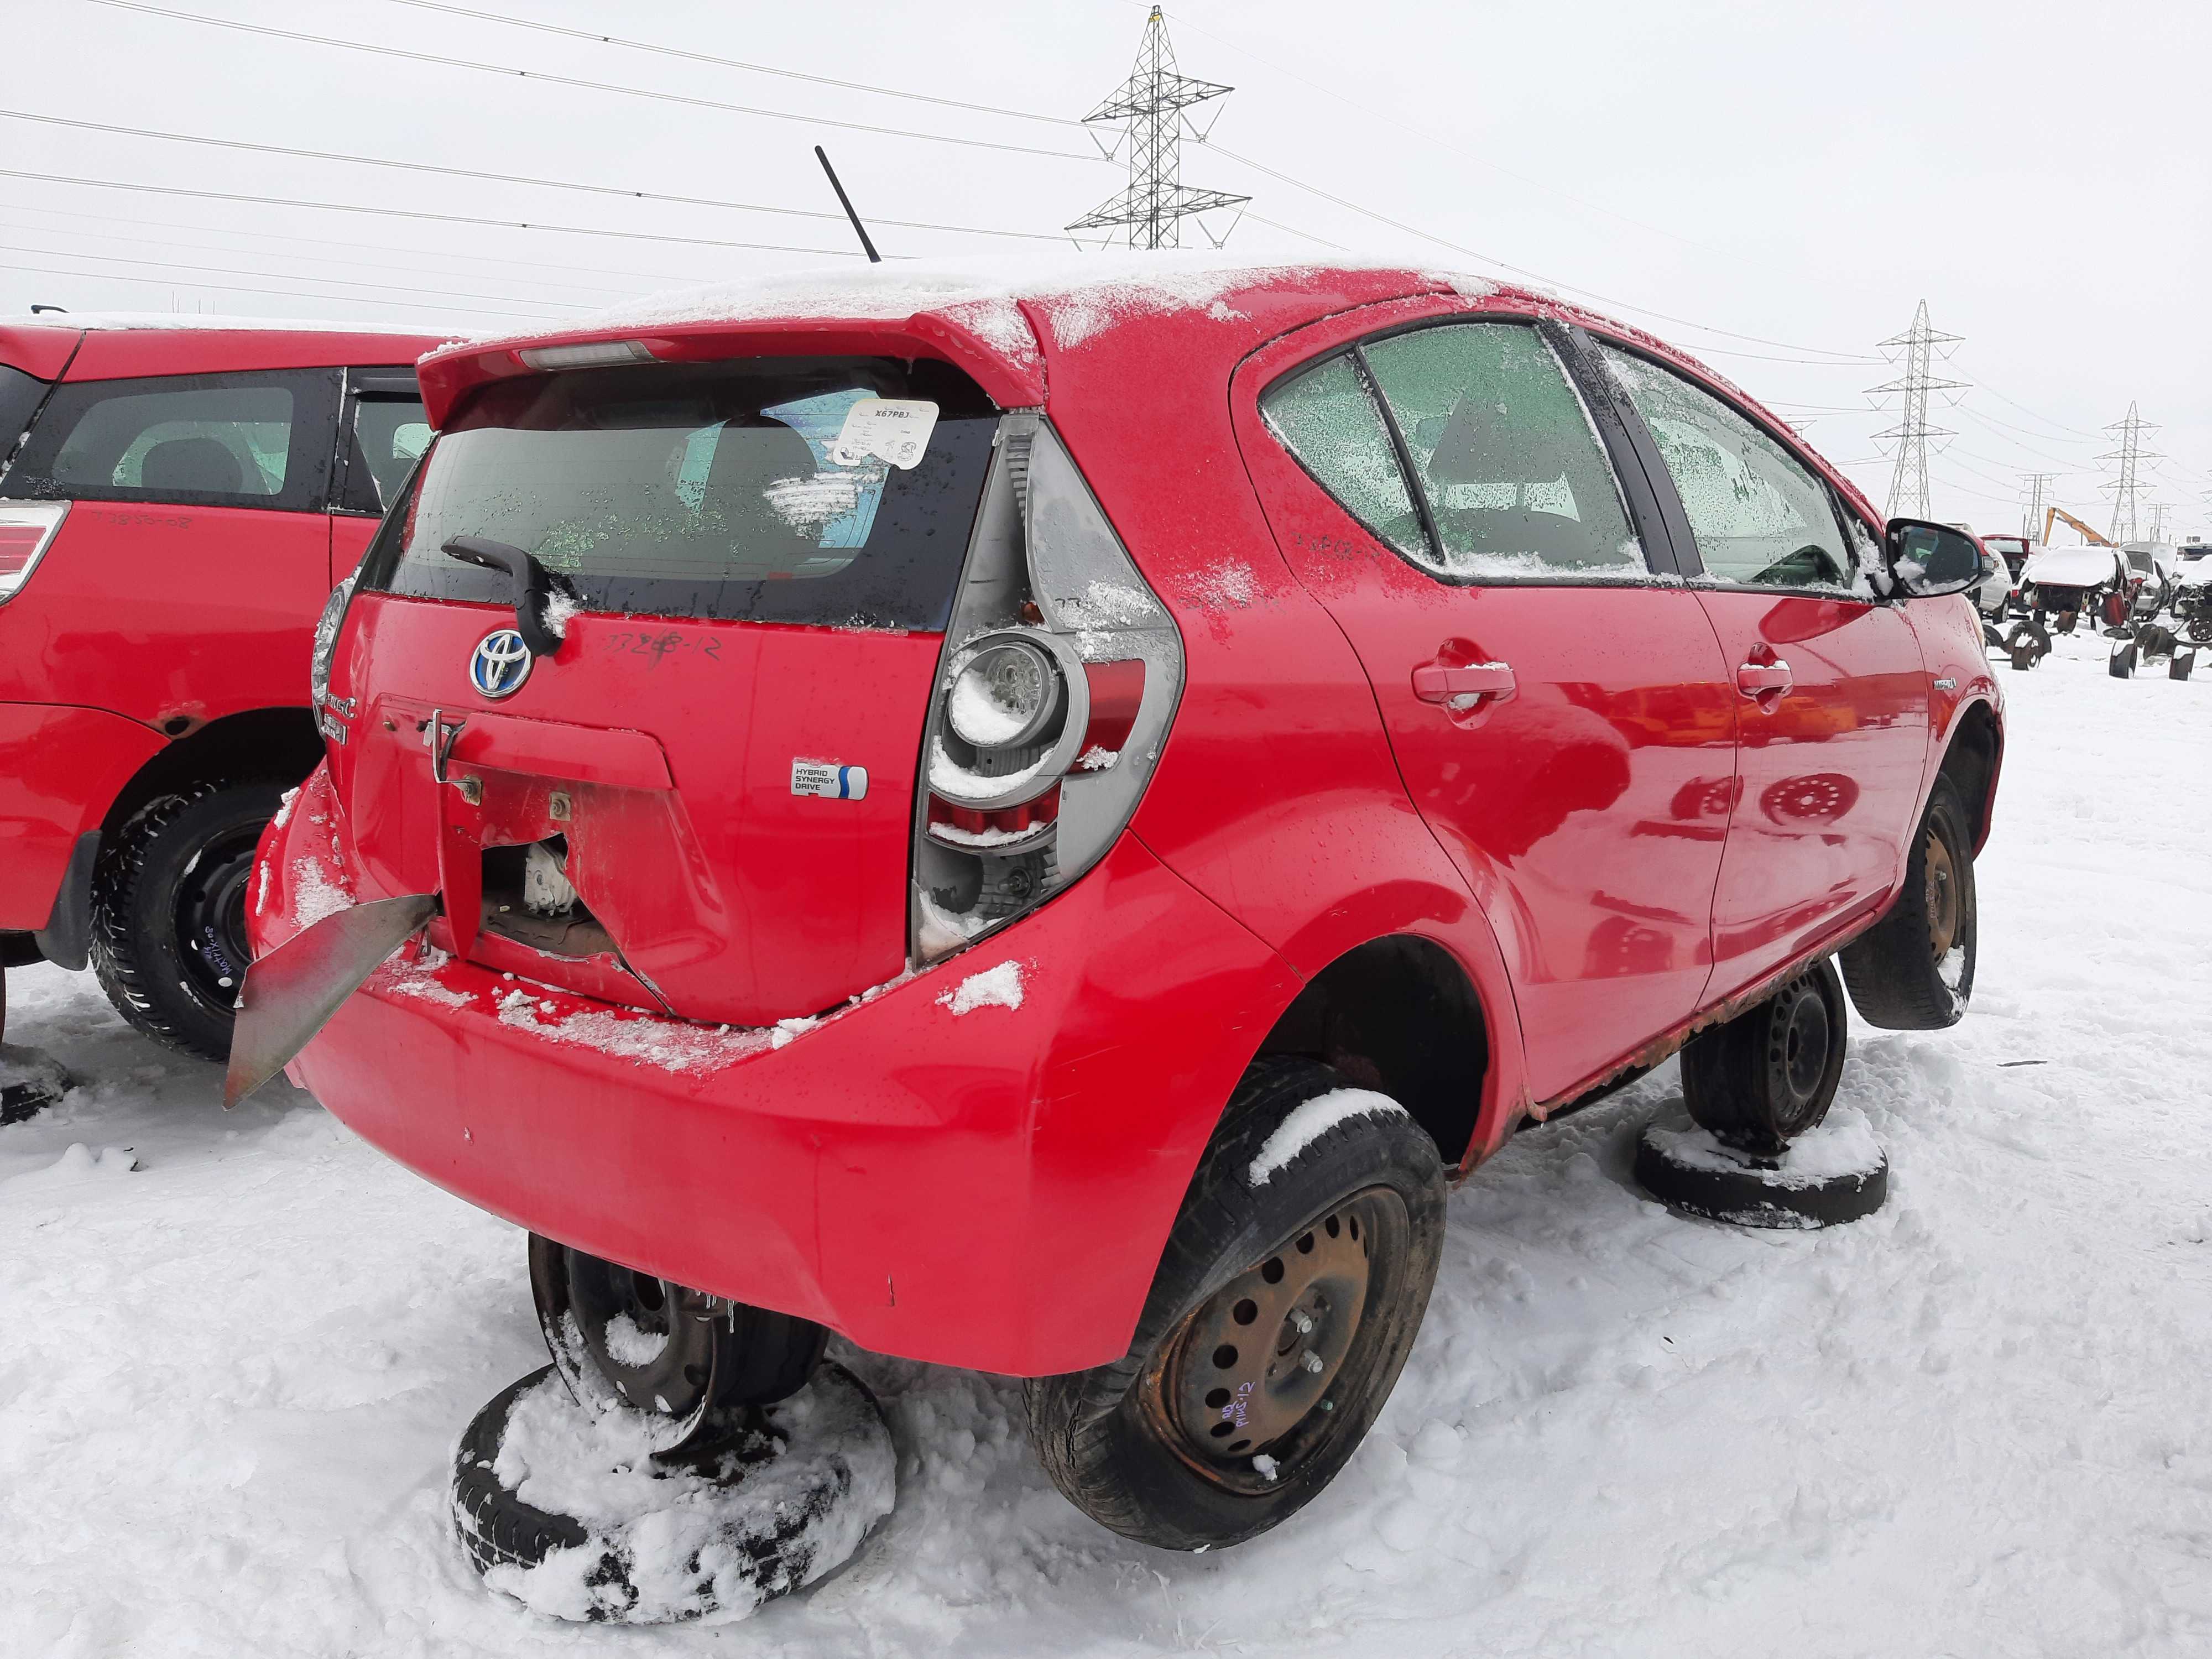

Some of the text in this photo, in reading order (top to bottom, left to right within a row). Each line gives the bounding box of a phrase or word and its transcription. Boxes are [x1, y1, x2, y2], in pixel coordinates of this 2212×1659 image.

[875, 410, 910, 419] X67PBJ
[796, 768, 828, 776] HYBRID
[795, 775, 835, 784] SYNERGY
[795, 782, 821, 791] DRIVE
